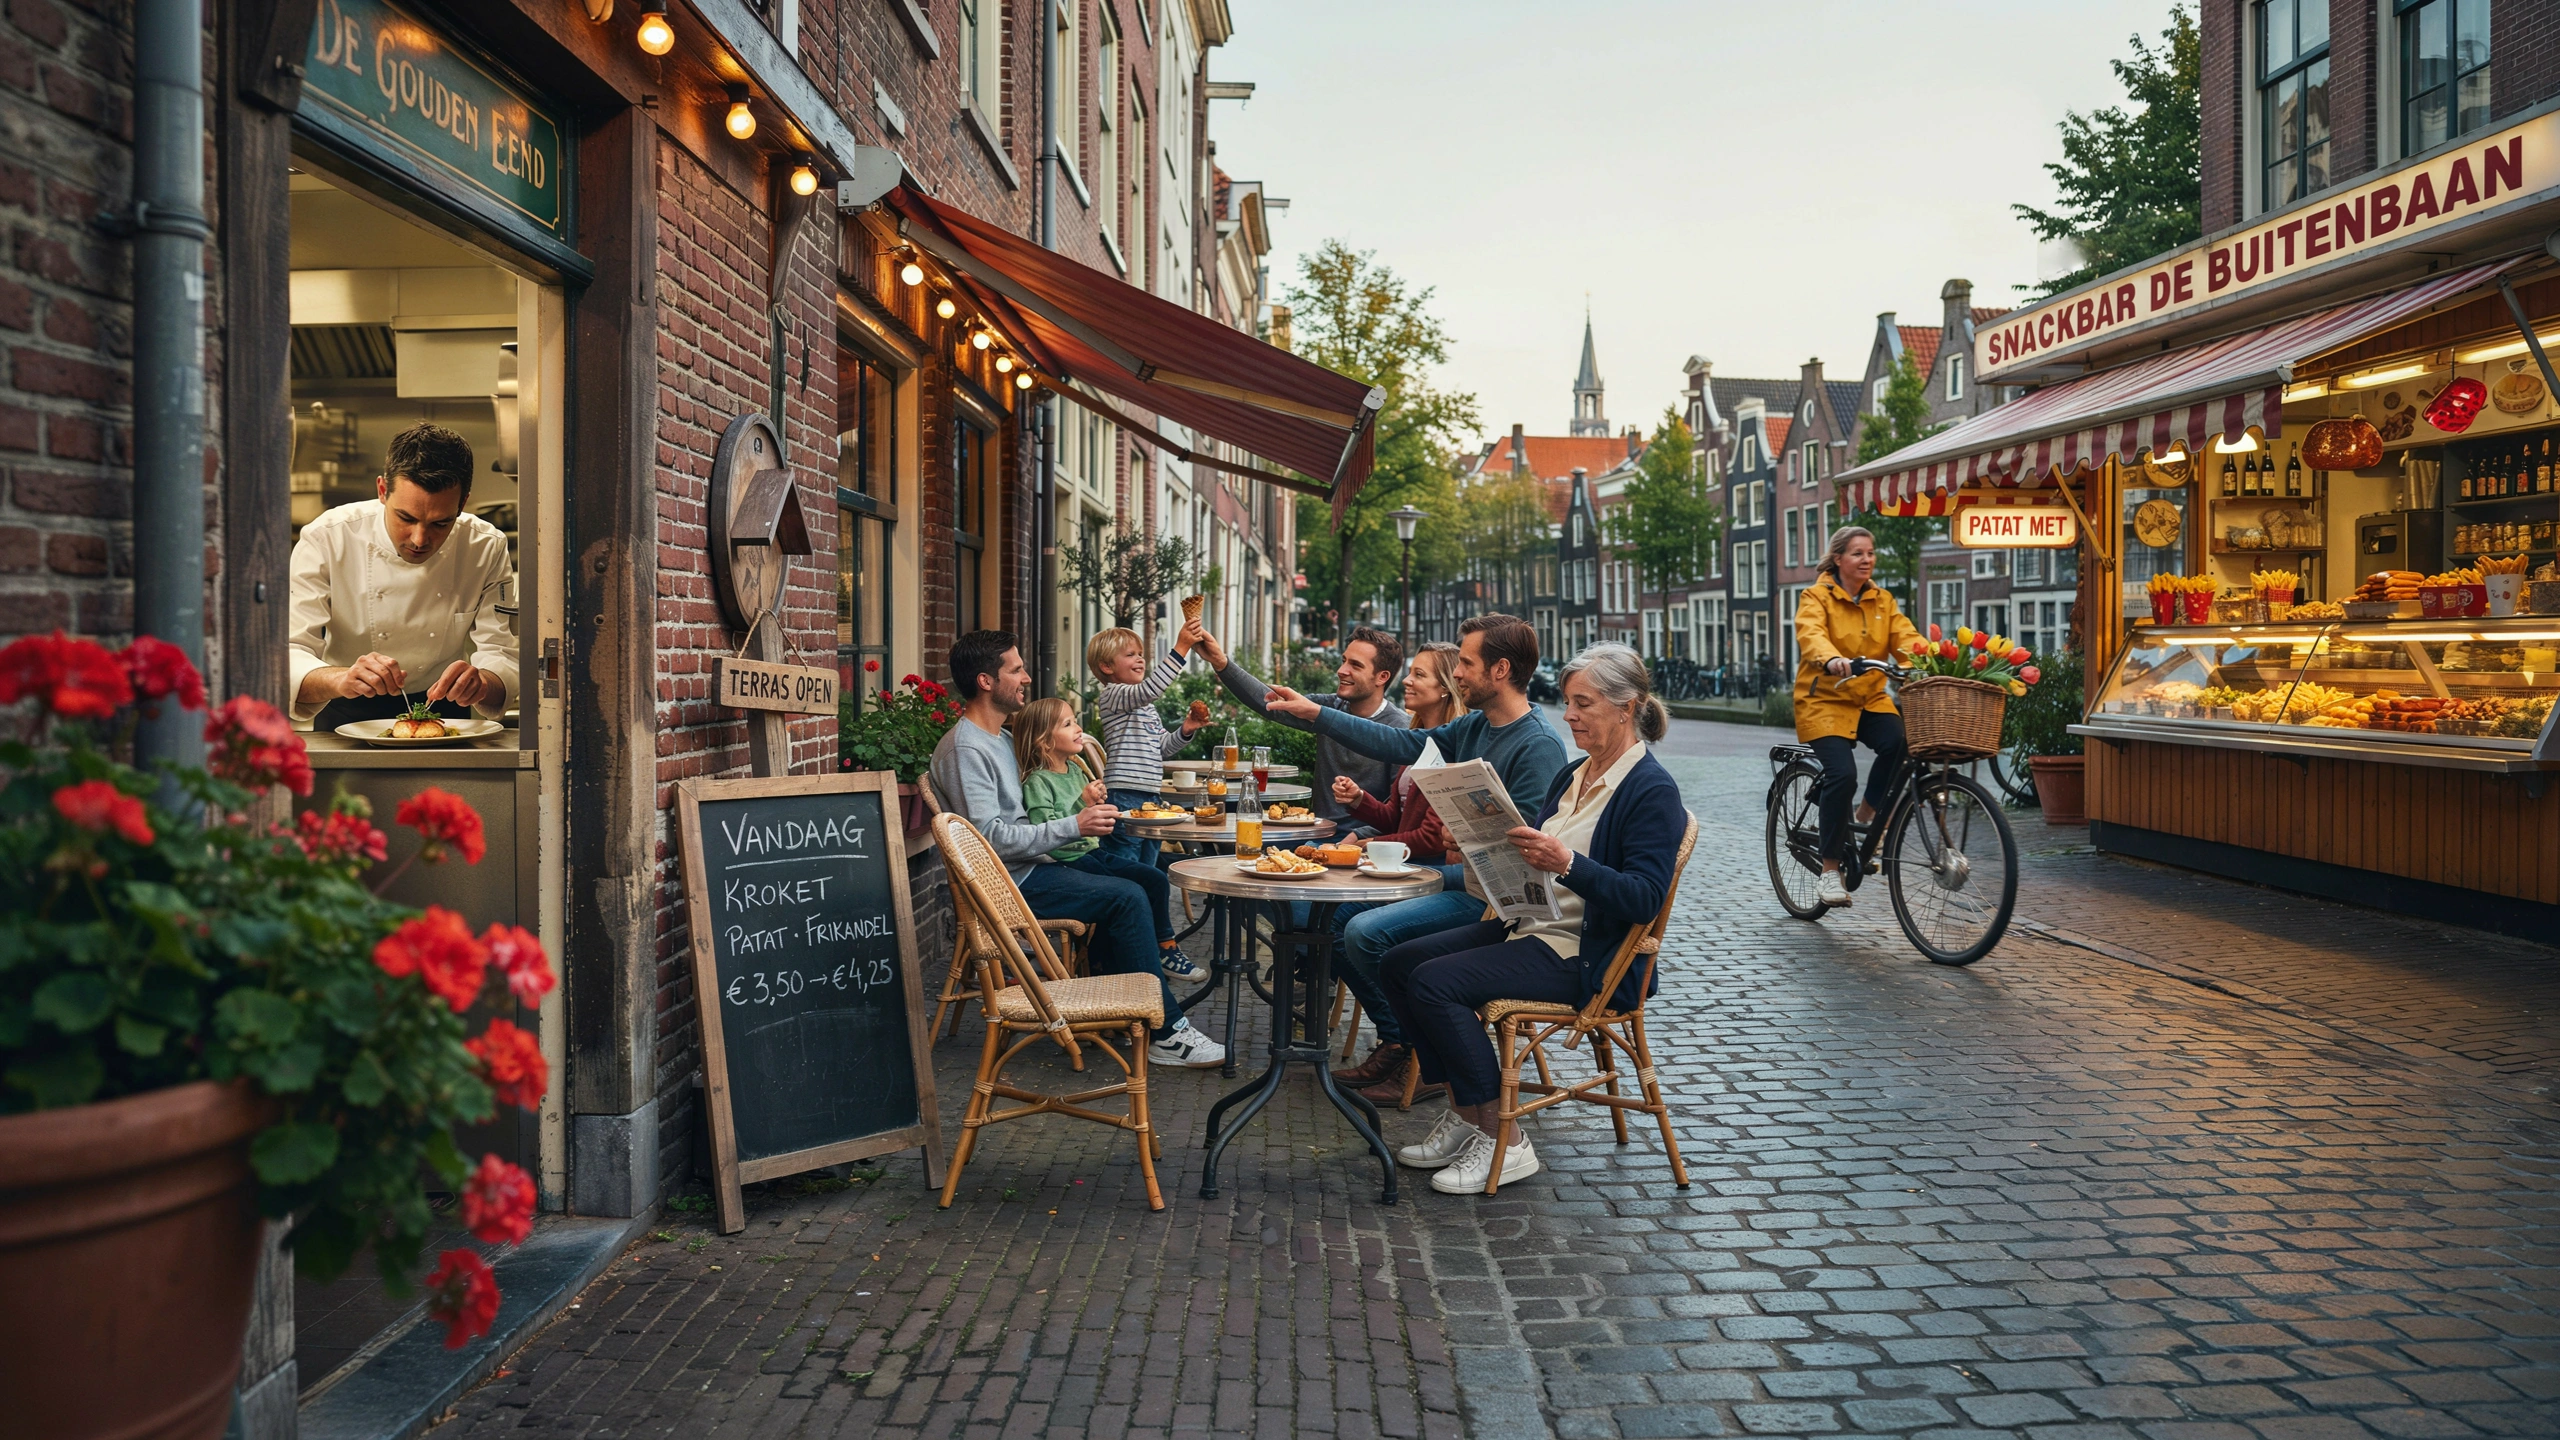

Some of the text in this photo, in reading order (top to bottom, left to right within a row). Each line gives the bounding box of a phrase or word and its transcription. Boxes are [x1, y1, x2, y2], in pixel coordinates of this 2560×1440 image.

[314, 0, 546, 189] DE GOUDEN EEND
[1988, 135, 2523, 365] SNACKBAR DE BUITENBAAN
[1969, 516, 2067, 536] PATAT MET
[730, 669, 831, 703] TERRAS OPEN
[722, 812, 865, 855] VANDAAG
[724, 876, 834, 912] KROKET
[724, 925, 788, 956] PATAT
[805, 913, 894, 946] FRIKANDEL
